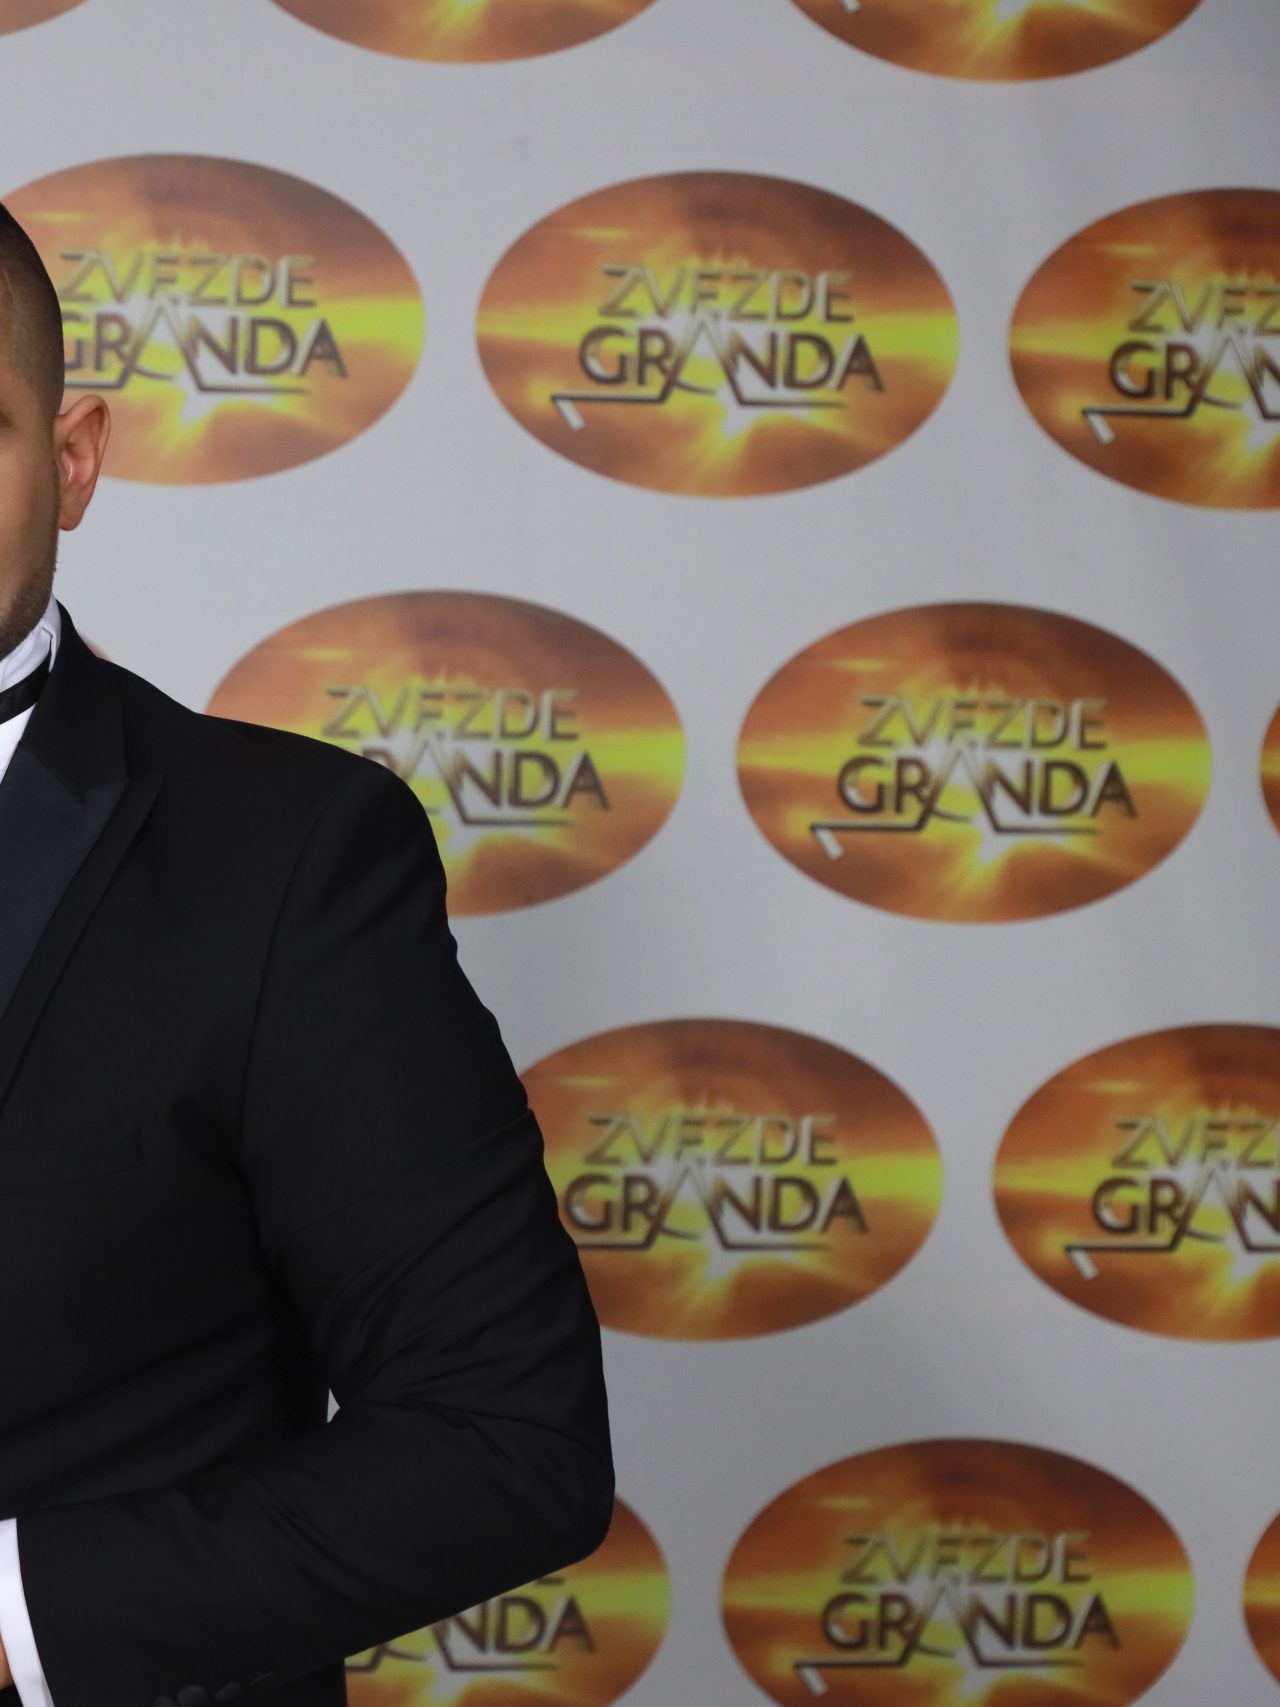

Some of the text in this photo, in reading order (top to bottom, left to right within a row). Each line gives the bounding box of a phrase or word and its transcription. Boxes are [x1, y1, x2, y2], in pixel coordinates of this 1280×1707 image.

[1129, 280, 1280, 335] ZVEZ
[578, 308, 885, 406] GRANDA
[836, 737, 1139, 834] GRANDA
[1111, 1116, 1280, 1169] ZVEZ
[564, 1155, 870, 1251] GRANDA
[1091, 1160, 1280, 1254] GRAN
[821, 1573, 1120, 1667] GRANDA
